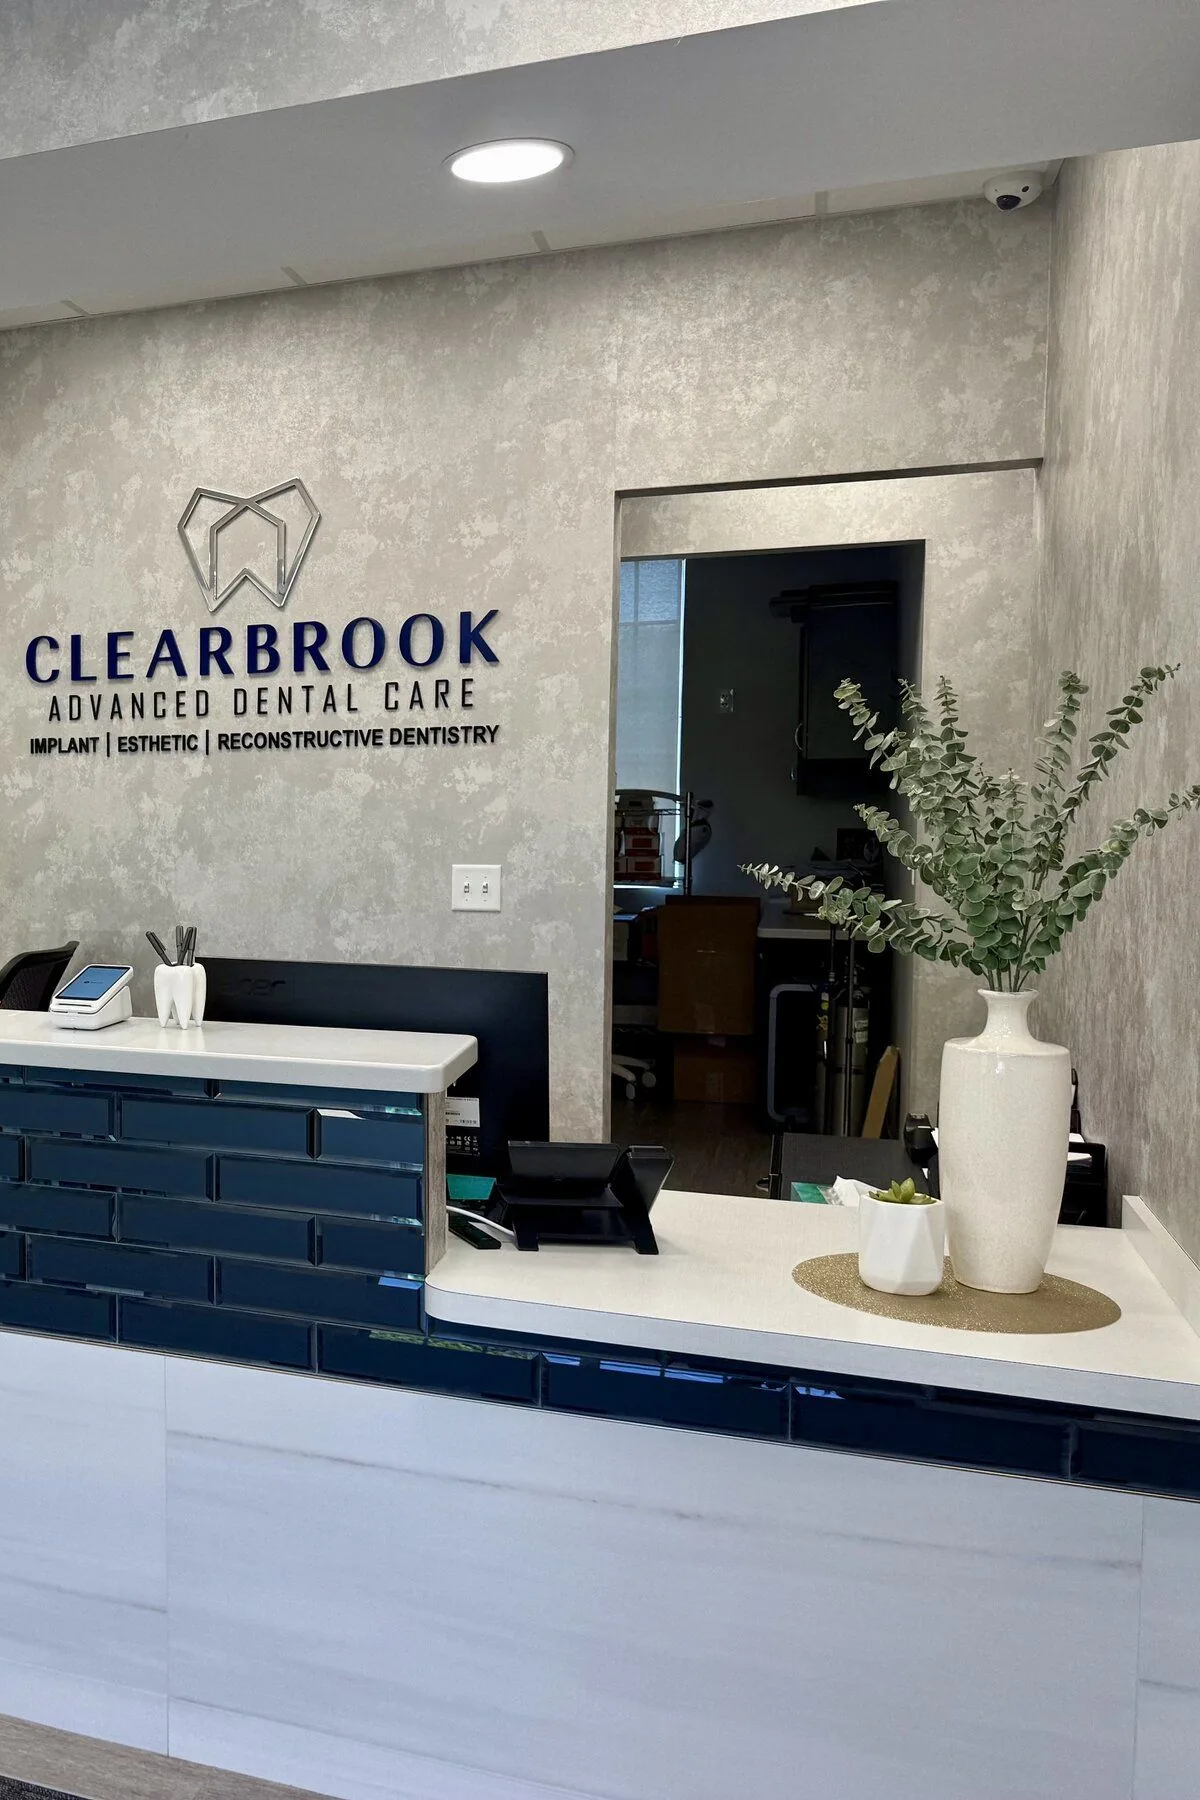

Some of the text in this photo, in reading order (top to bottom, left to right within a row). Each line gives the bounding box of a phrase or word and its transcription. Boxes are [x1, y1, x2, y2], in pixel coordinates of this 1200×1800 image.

[25, 609, 500, 683] CLEARBROOK
[49, 678, 474, 721] ADVANCED DENTAL CARE
[30, 737, 100, 754] IMPLANT
[117, 734, 198, 752] ESTHETIC
[218, 728, 384, 750] RECONSTRUCTIVE
[389, 725, 500, 746] DENTISTRY
